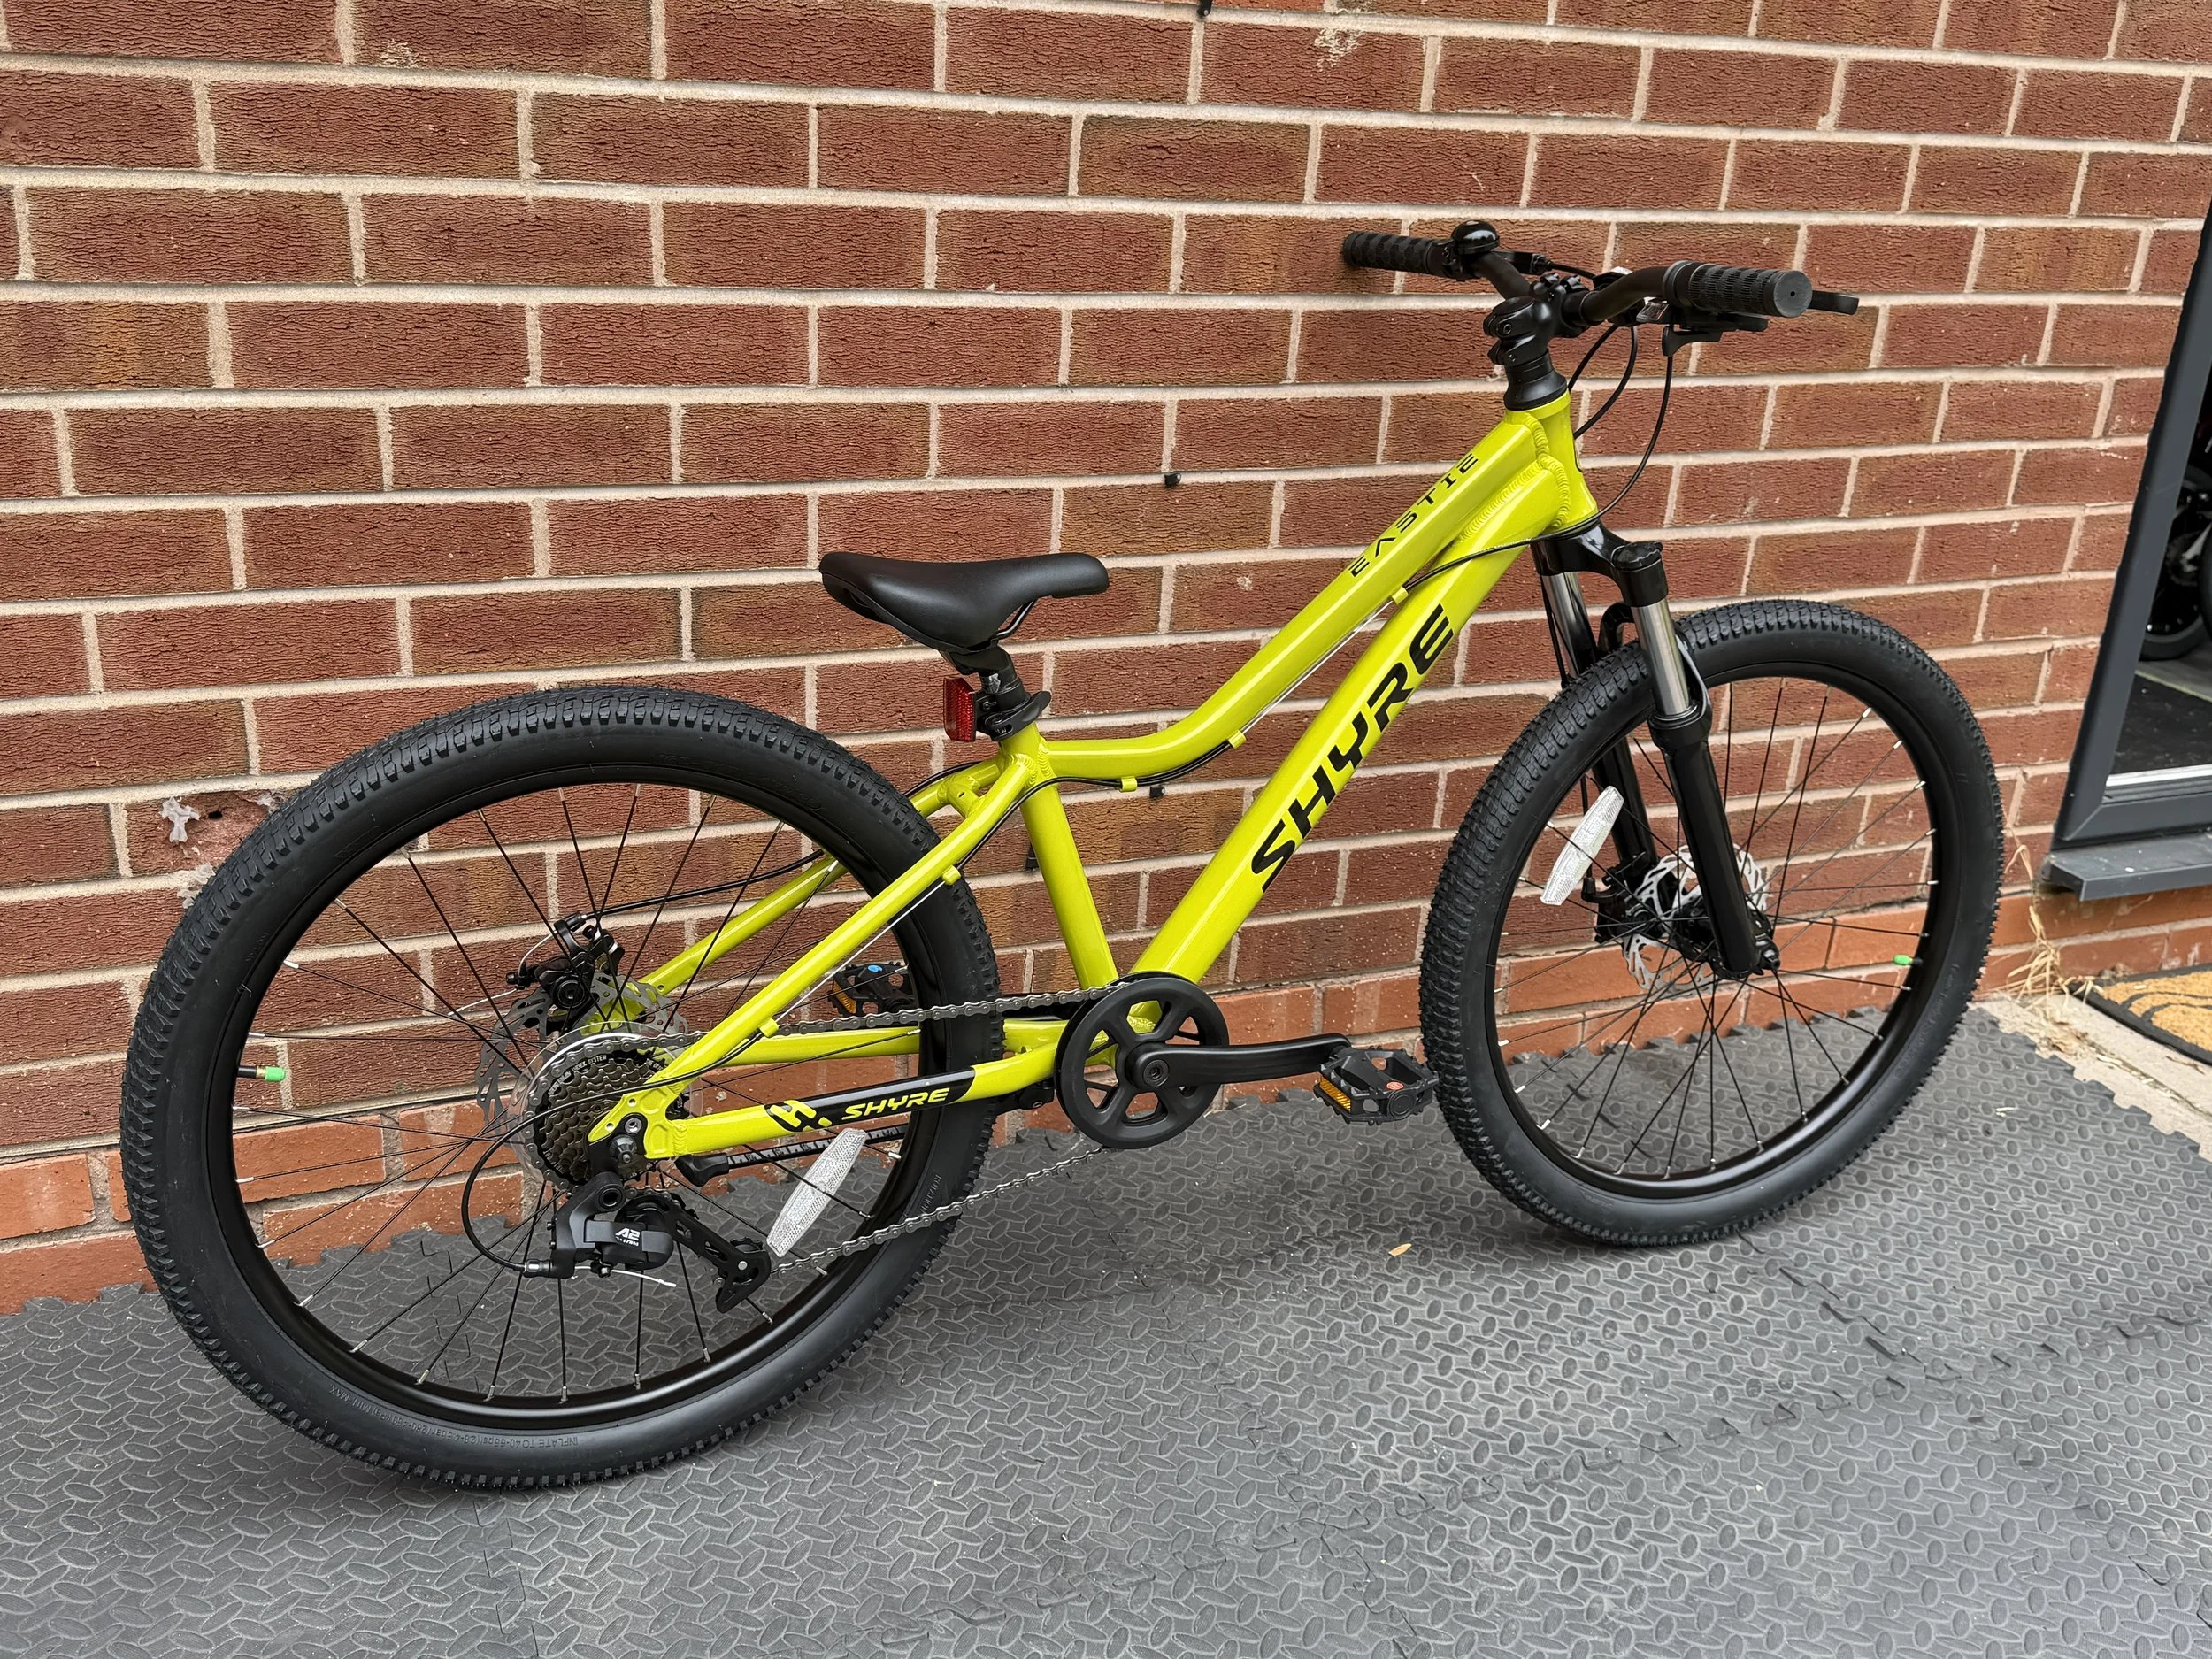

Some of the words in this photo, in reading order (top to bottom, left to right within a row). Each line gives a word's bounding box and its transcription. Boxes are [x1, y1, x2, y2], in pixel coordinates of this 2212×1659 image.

[1349, 453, 1478, 578] EASTIE
[1251, 603, 1455, 894] SHYRE
[841, 1087, 950, 1120] SHYRE
[538, 1436, 579, 1449] INFLATE
